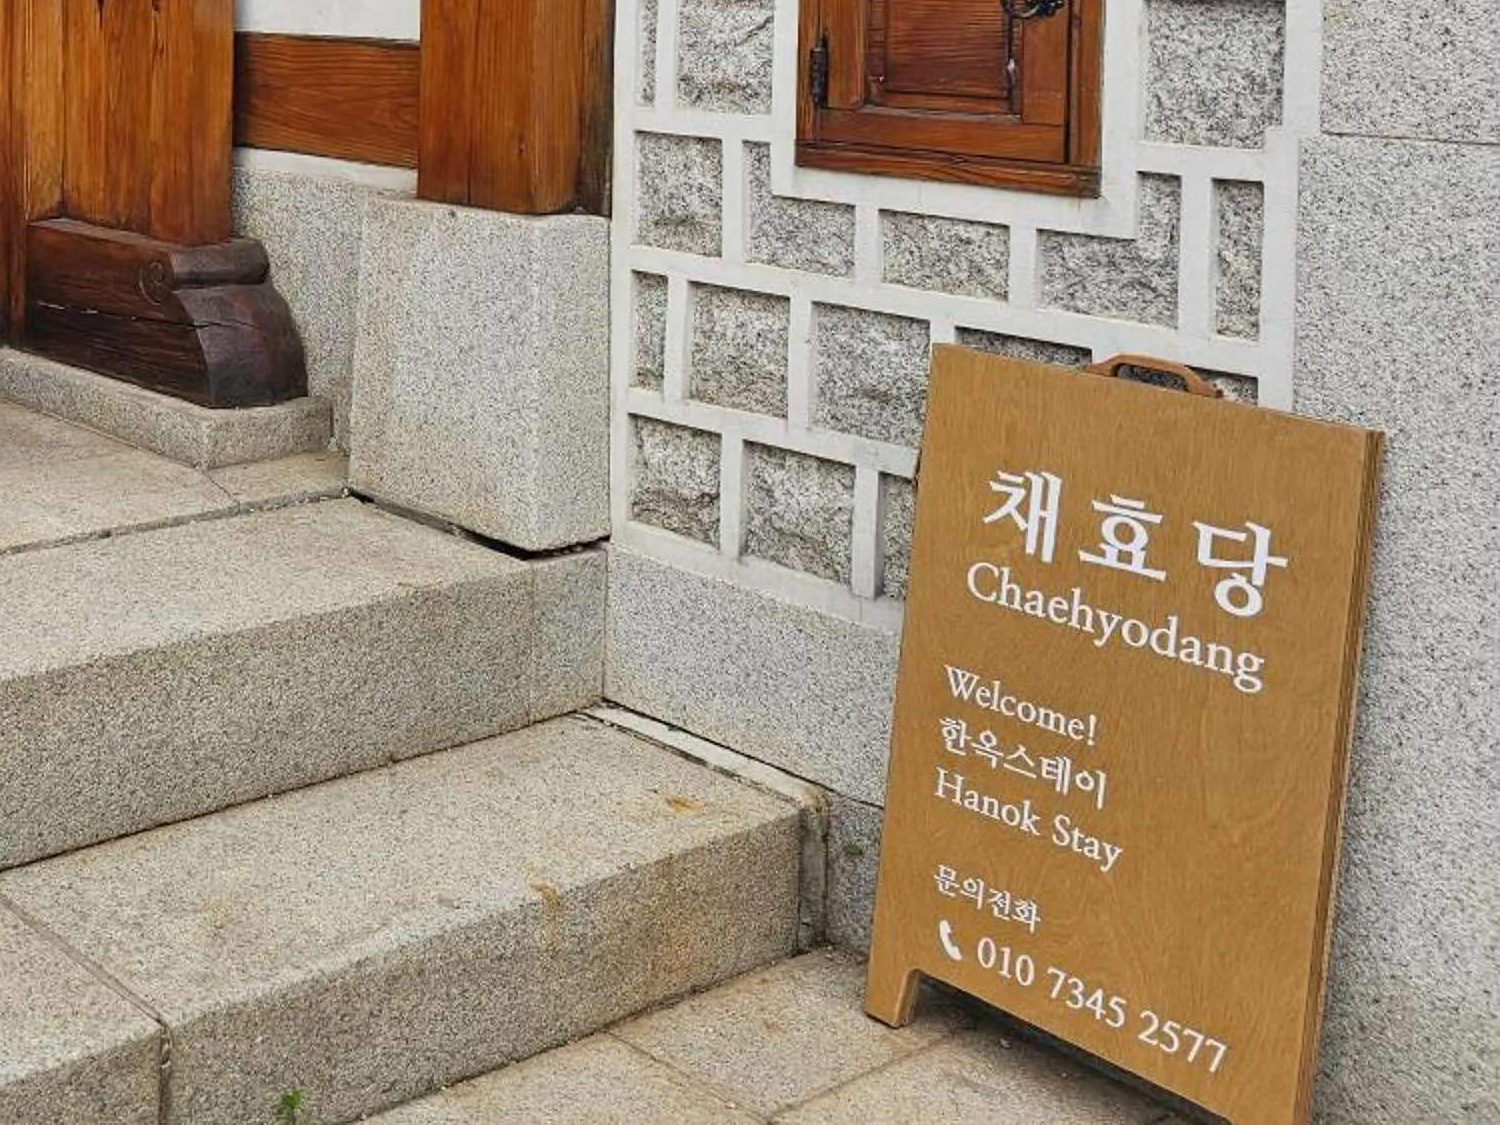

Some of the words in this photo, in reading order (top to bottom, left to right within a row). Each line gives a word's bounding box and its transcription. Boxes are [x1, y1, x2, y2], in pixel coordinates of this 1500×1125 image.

[982, 469, 1288, 619] 채효당
[966, 561, 1266, 695] Chaehyodang
[944, 665, 1100, 745] Welcome!
[940, 716, 1108, 810] 한옥스테이
[934, 768, 1040, 837] Hanok
[1052, 811, 1123, 872] Stay
[934, 865, 1042, 934] 문의전화
[976, 937, 1036, 987] 010
[1046, 967, 1127, 1029] 7345
[1137, 1011, 1229, 1074] 2577
